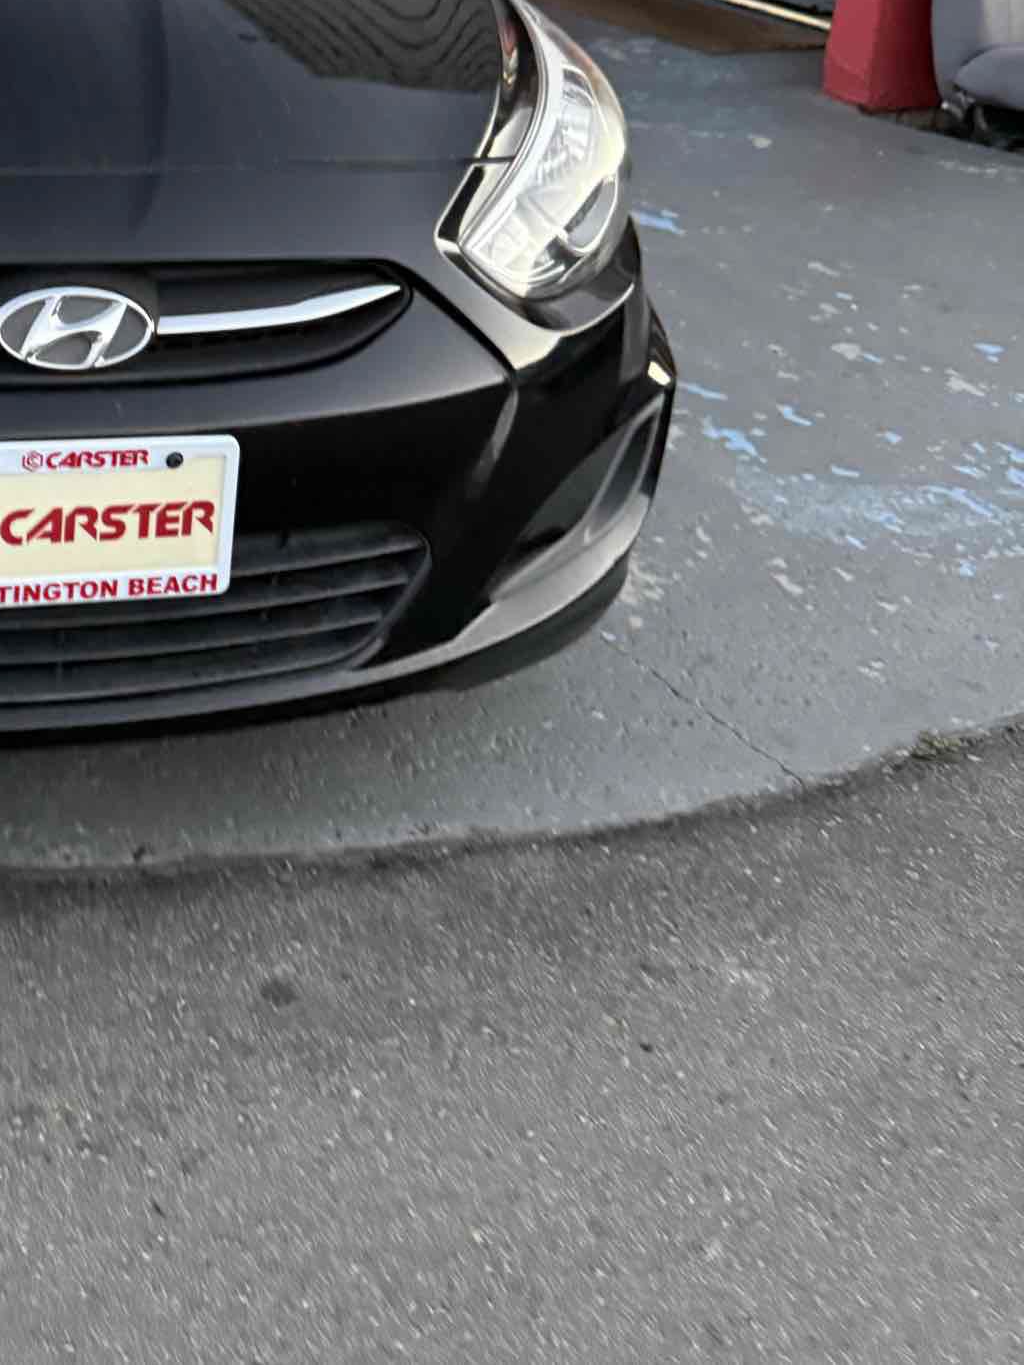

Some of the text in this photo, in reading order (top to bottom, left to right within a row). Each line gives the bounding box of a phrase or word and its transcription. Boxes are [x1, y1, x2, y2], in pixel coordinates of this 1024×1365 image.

[46, 449, 150, 470] CARSTER
[0, 500, 216, 546] CARSTER
[128, 574, 218, 597] BEACH
